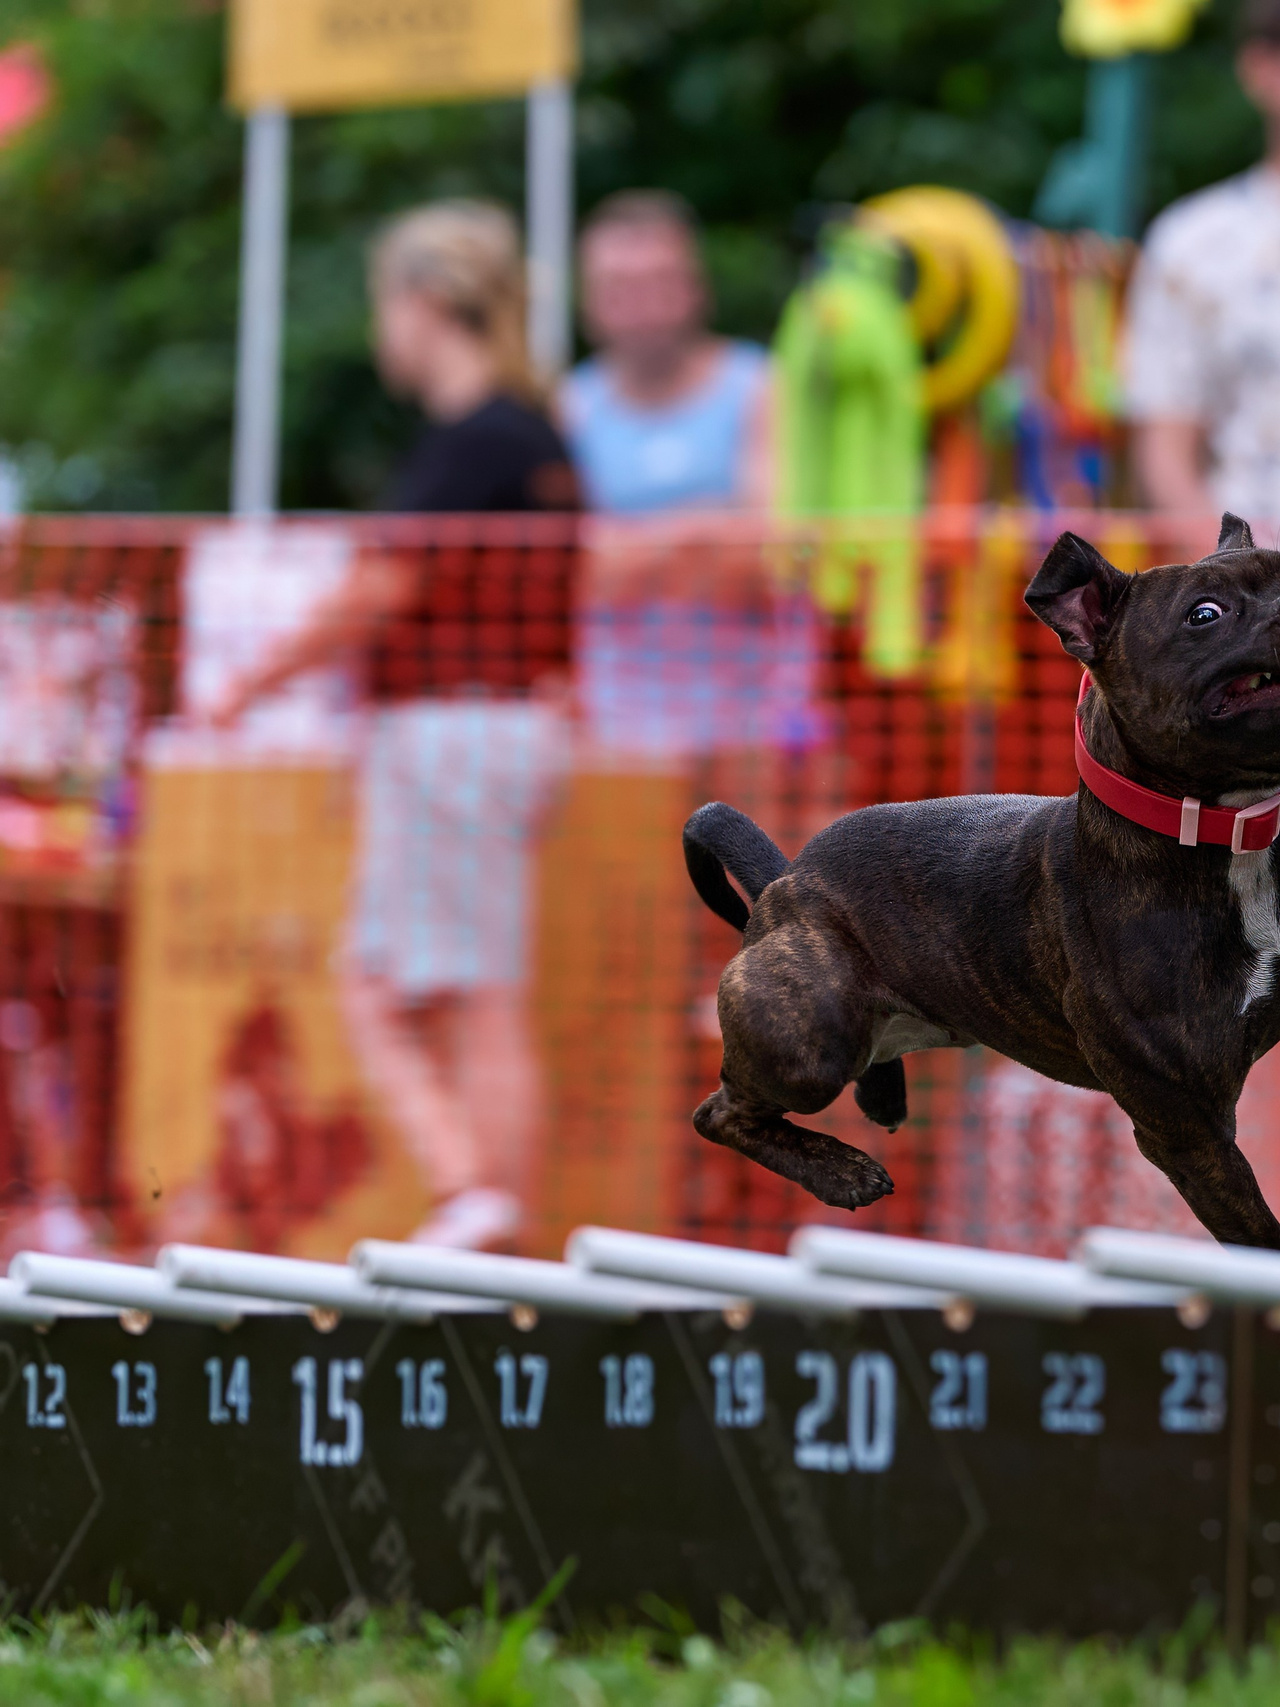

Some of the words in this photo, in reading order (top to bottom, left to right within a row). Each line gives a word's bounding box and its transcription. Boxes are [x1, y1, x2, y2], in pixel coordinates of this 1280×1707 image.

[205, 1357, 250, 1423] 1.4
[292, 1357, 364, 1467] 1.5
[794, 1351, 896, 1472] 2.0
